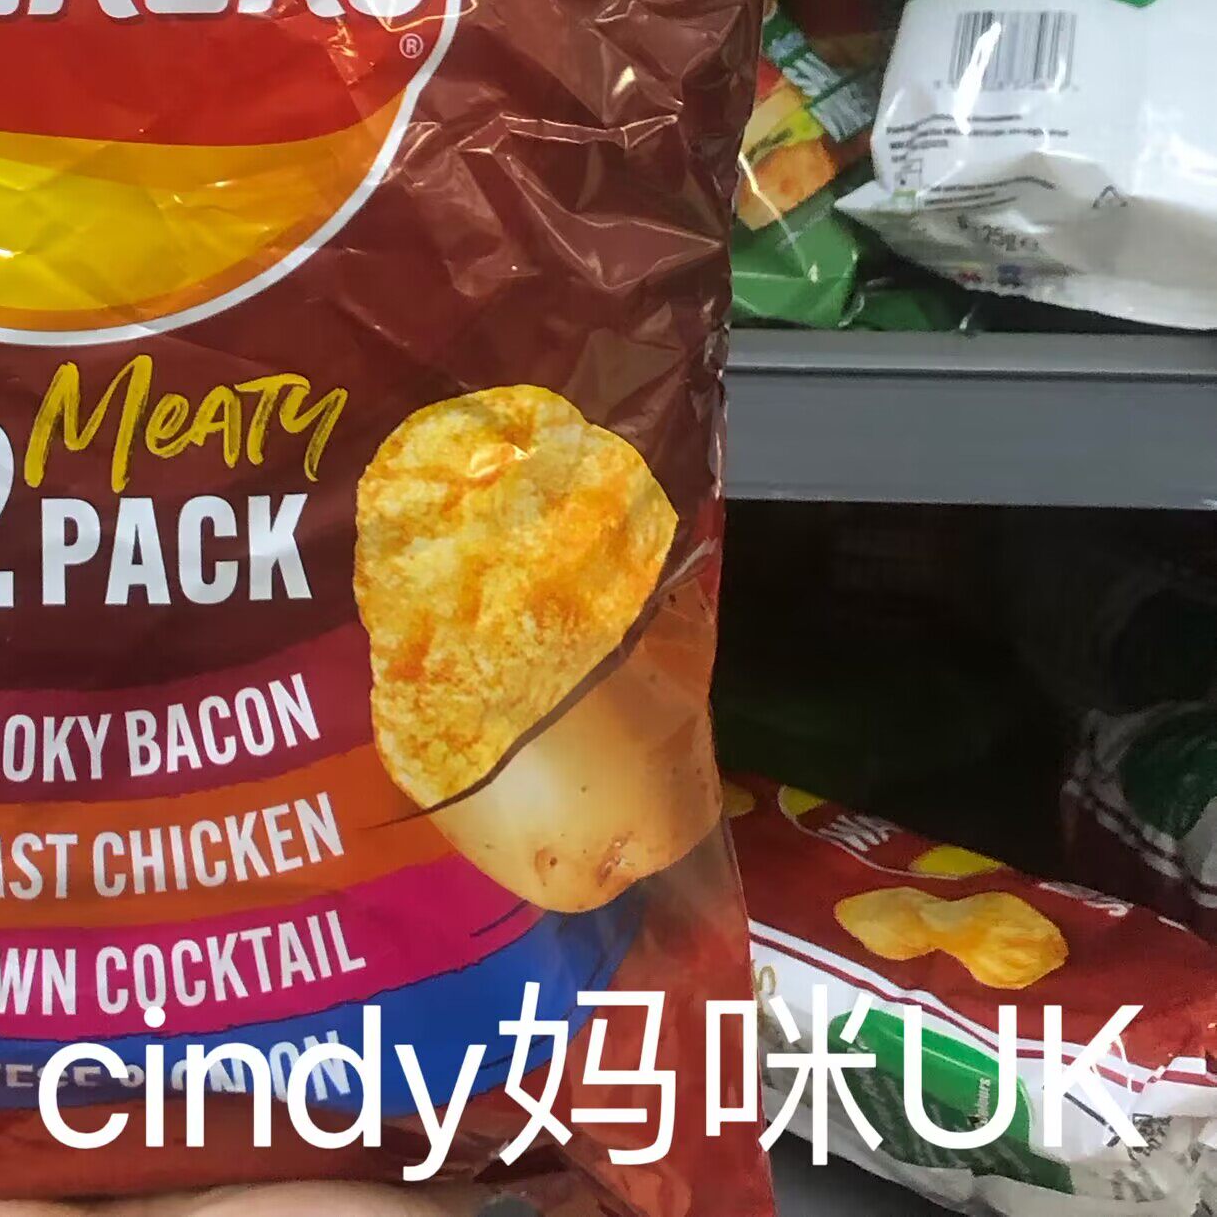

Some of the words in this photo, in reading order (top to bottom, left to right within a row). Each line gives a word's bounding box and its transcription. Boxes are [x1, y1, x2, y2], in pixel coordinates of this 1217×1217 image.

[40, 493, 312, 606] PACK
[124, 673, 321, 777] BACON
[93, 791, 345, 897] CHICKEN
[95, 909, 366, 1016] COCKTAIL
